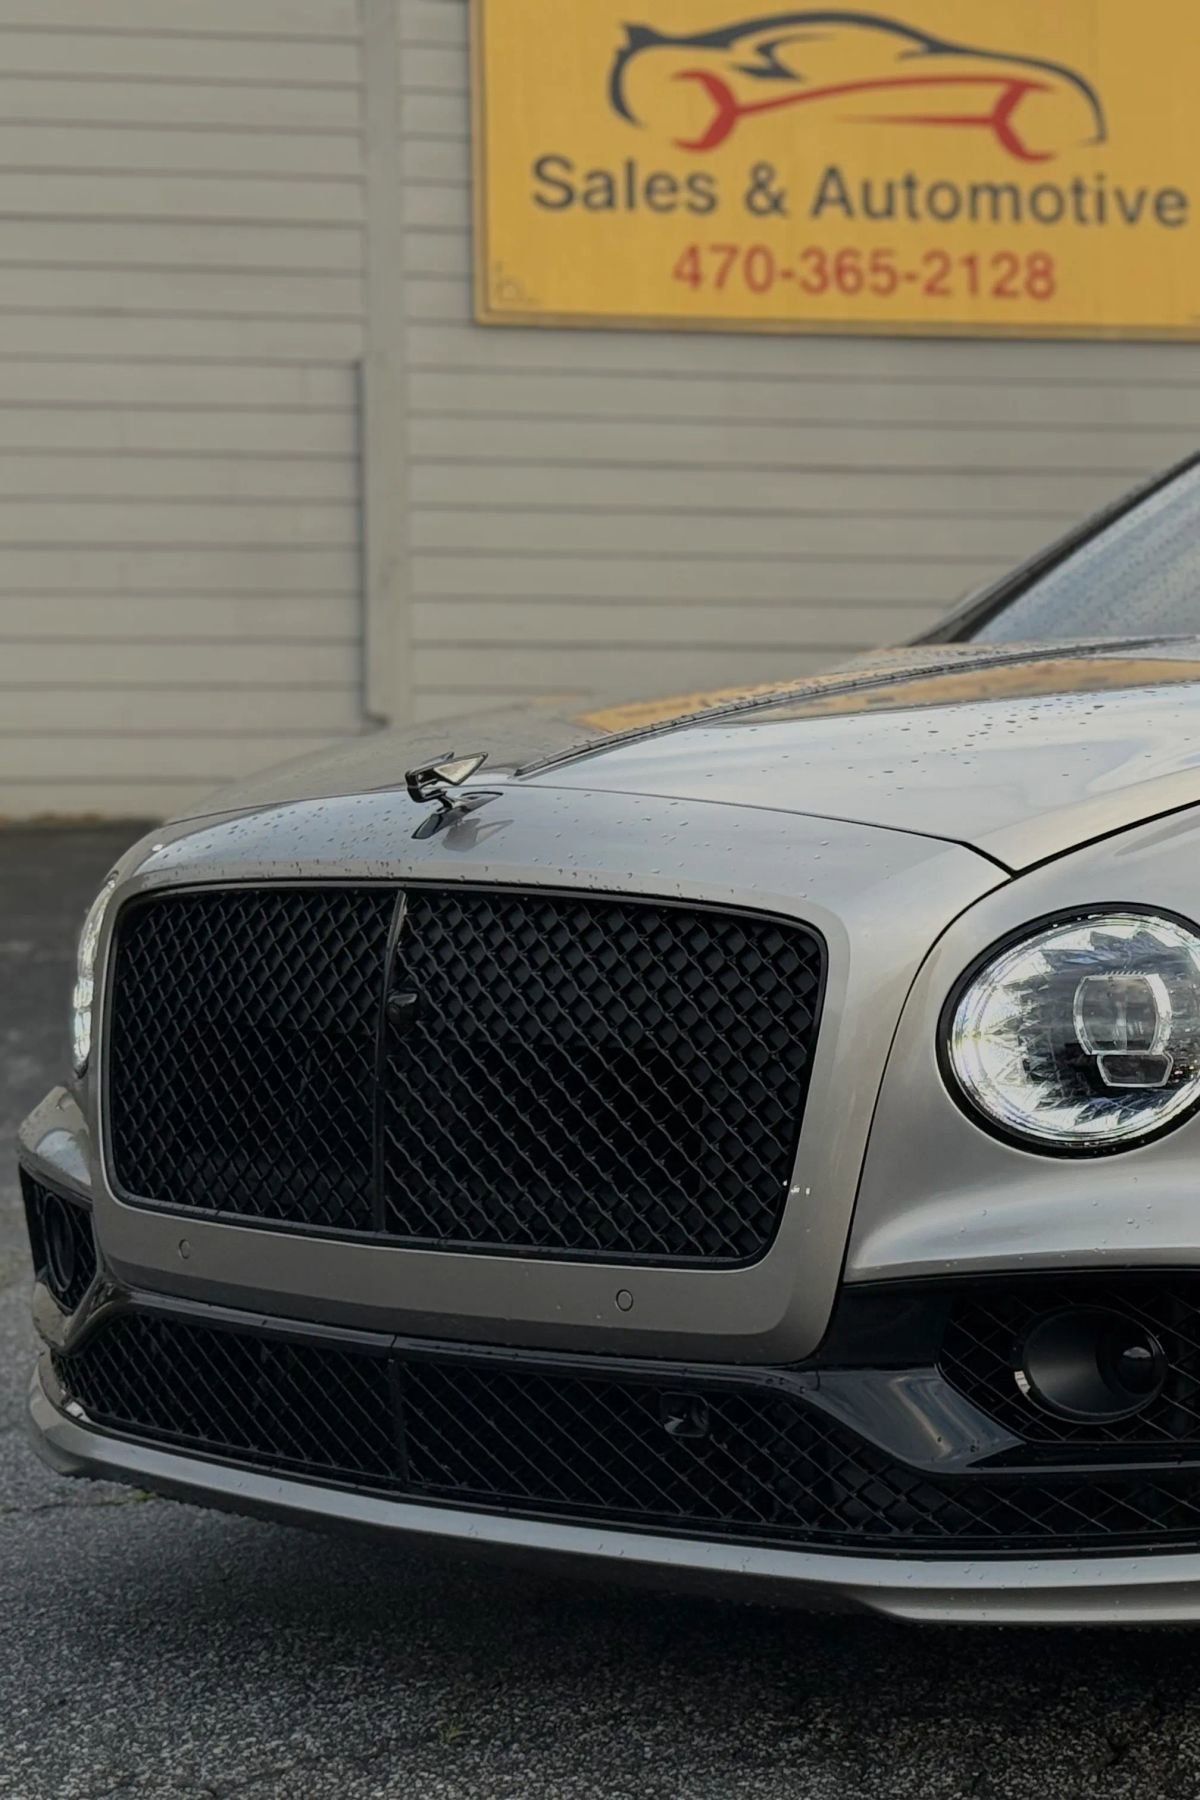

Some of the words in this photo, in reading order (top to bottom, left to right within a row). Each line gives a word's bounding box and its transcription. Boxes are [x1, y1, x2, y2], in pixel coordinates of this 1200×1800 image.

[532, 153, 718, 214] Sales
[744, 160, 787, 217] &
[810, 164, 1189, 228] Automotive
[672, 244, 1056, 300] 470-365-2128
